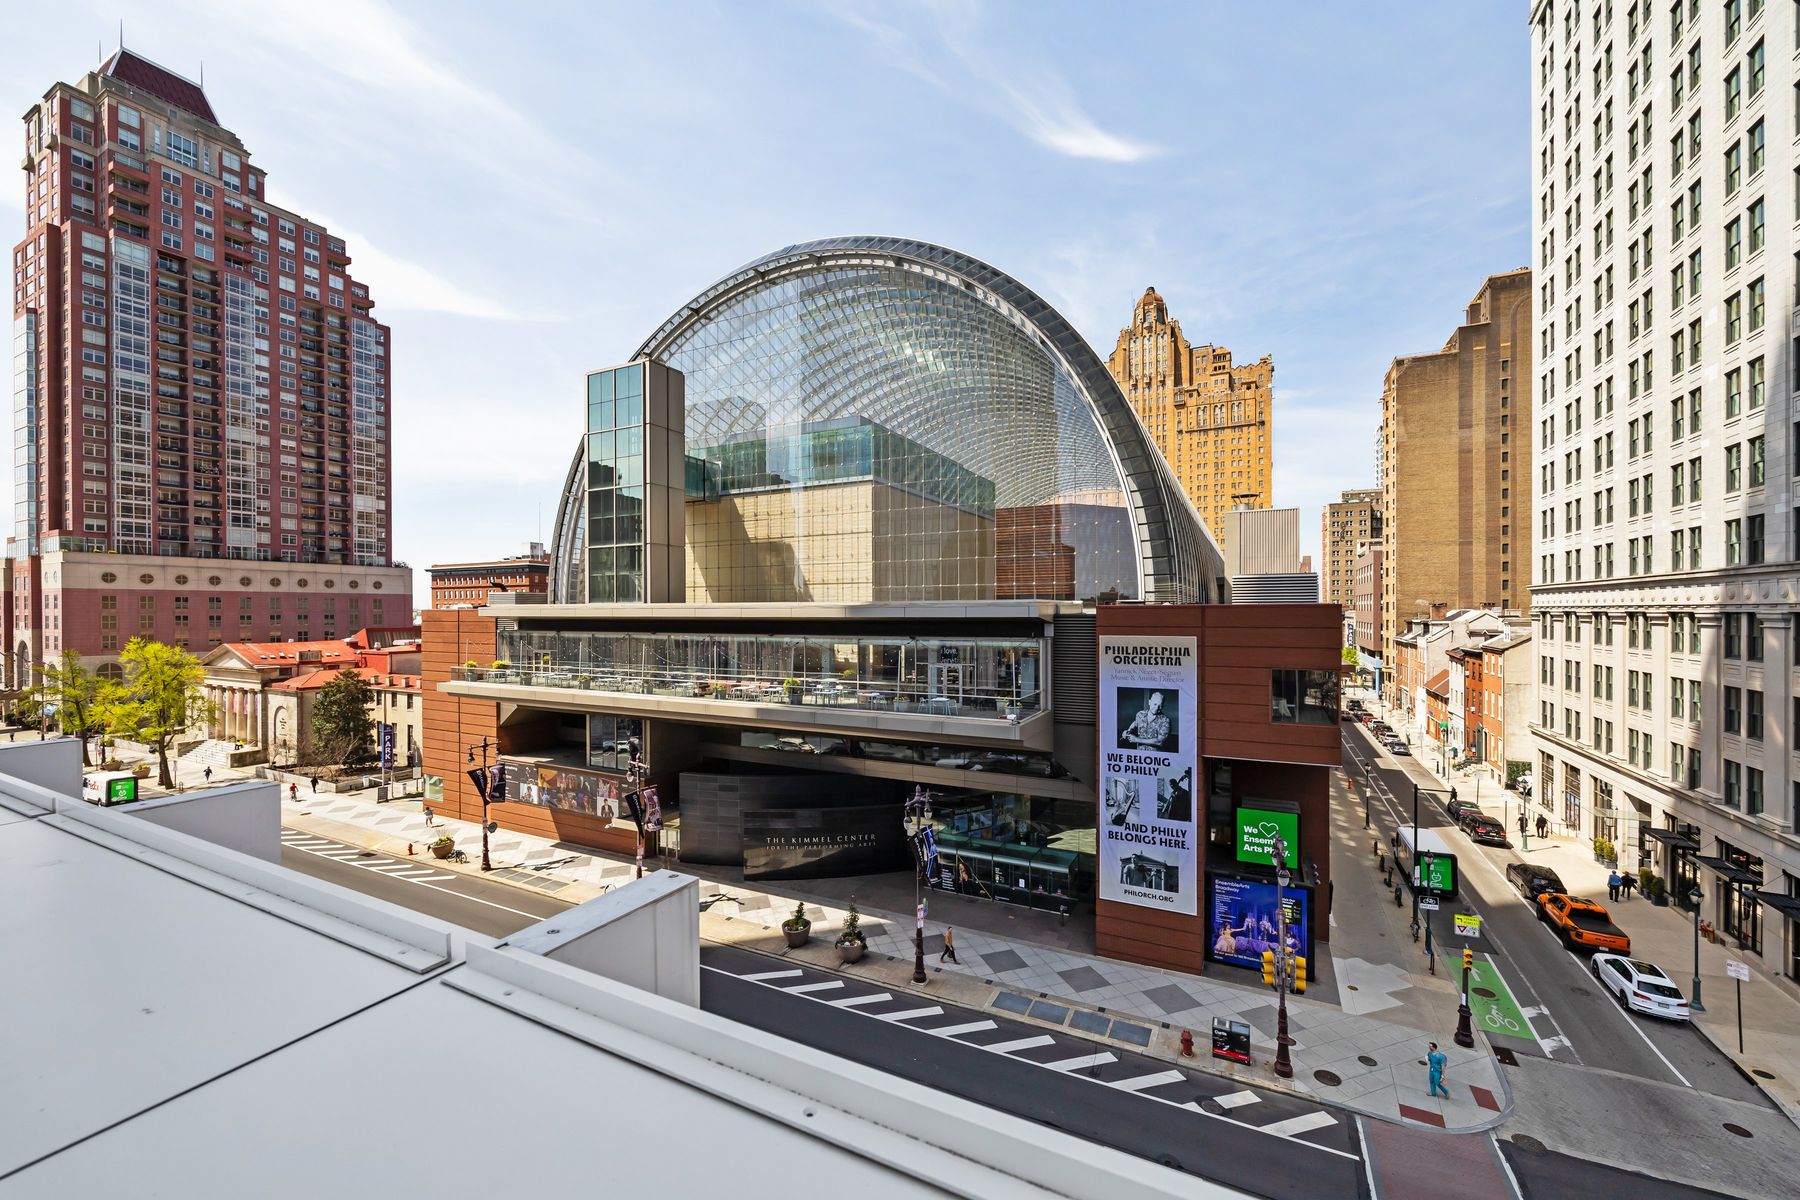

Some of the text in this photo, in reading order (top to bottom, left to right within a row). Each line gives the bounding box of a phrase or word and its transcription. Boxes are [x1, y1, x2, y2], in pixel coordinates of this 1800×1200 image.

[1104, 646, 1191, 657] PHILADELPHIA
[1113, 656, 1182, 666] ORCHESTRA
[1107, 753, 1171, 767] WE BELONG
[1107, 763, 1159, 776] TO PHILLY
[1124, 822, 1187, 839] AND PHILLY
[1243, 825, 1258, 834] We
[791, 836, 831, 844] KIMMEL
[837, 834, 876, 842] CENTER
[1108, 831, 1190, 850] BELONGS HERE.
[1243, 843, 1263, 853] Arts
[1215, 884, 1240, 893] Broadway
[1123, 889, 1174, 903] PHILORCH.ORG
